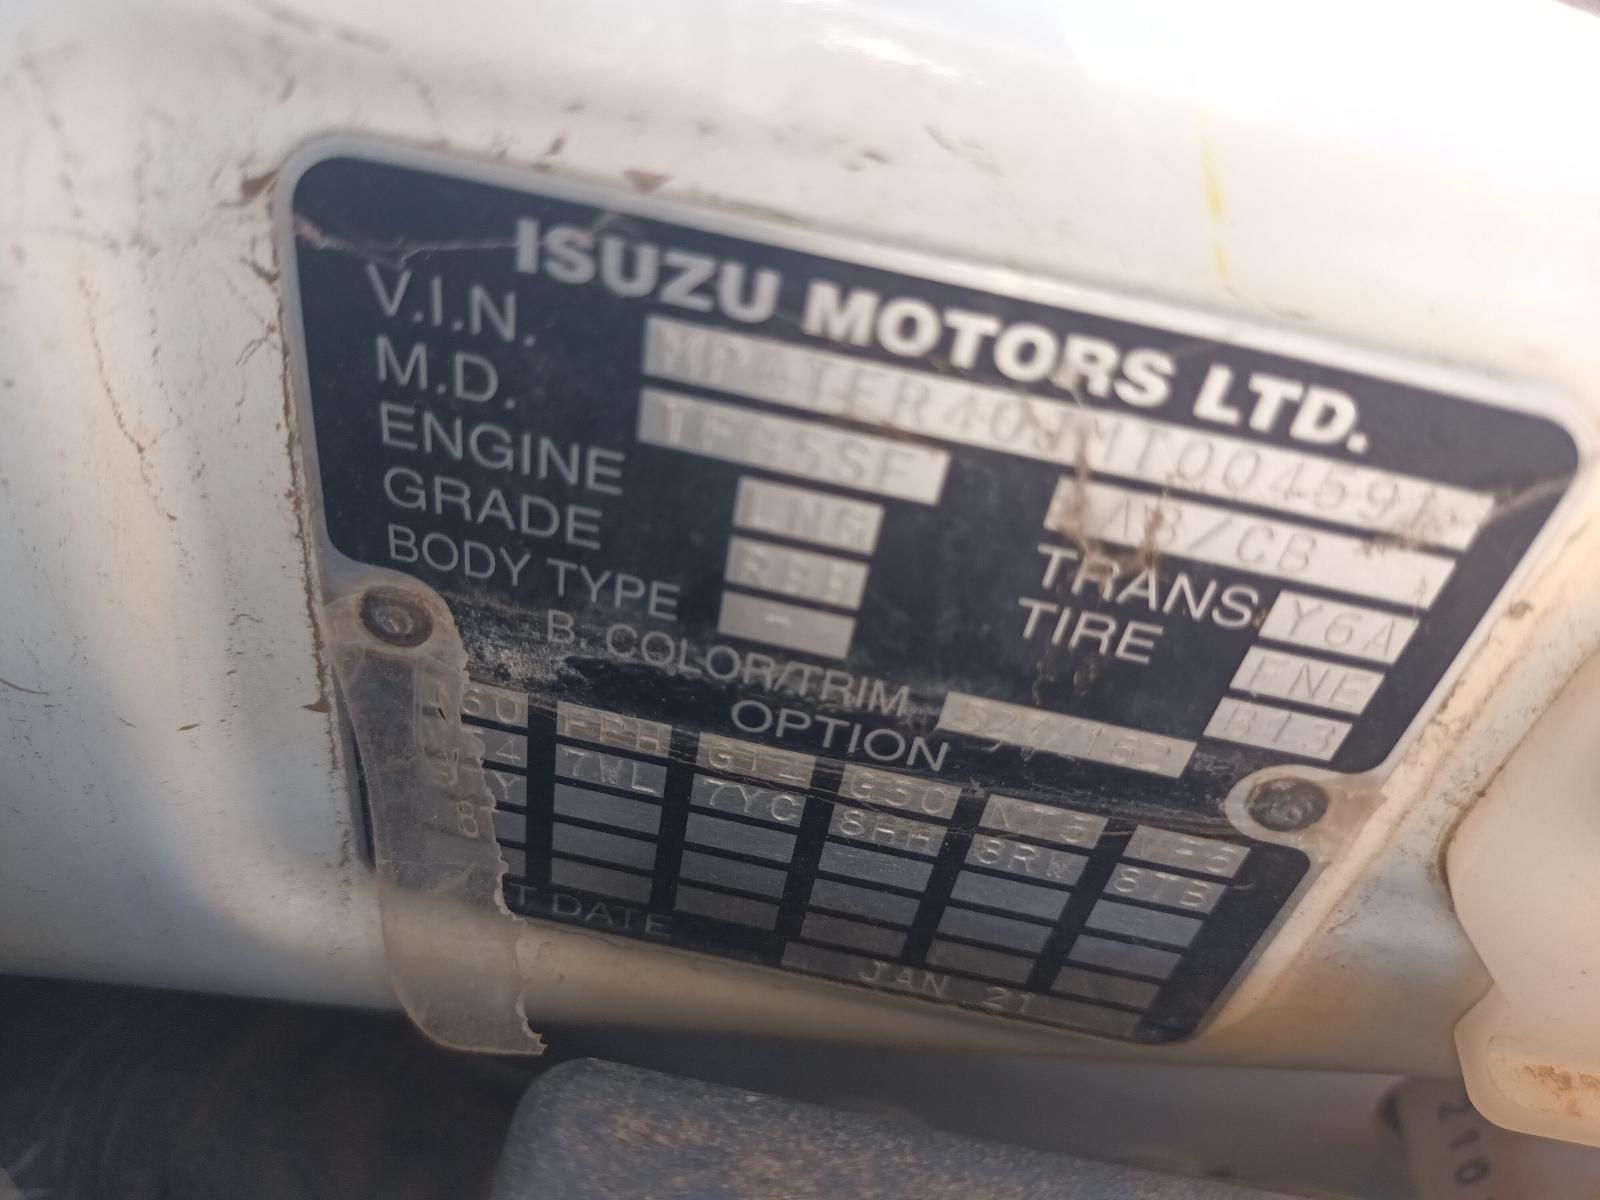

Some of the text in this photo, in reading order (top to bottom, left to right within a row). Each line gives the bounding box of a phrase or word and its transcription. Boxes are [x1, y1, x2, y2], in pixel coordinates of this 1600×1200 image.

[367, 264, 536, 347] V.I.N.
[515, 218, 1369, 454] ISUZU MOTORS LTD.
[375, 336, 516, 409] M.D.
[380, 402, 627, 495] ENGINE
[383, 468, 603, 549] GRADE
[388, 523, 531, 587] BODY
[547, 557, 682, 622] TYPE
[1037, 541, 1397, 658] TRANS Y6A
[546, 608, 588, 647] B.
[606, 622, 911, 717] COLOR/TRIM
[1018, 598, 1164, 666] TIRE
[730, 699, 950, 772] OPTION
[561, 746, 665, 799] 7WL
[703, 777, 801, 823] 7YC
[553, 892, 673, 937] DATE
[858, 959, 951, 999] JAN
